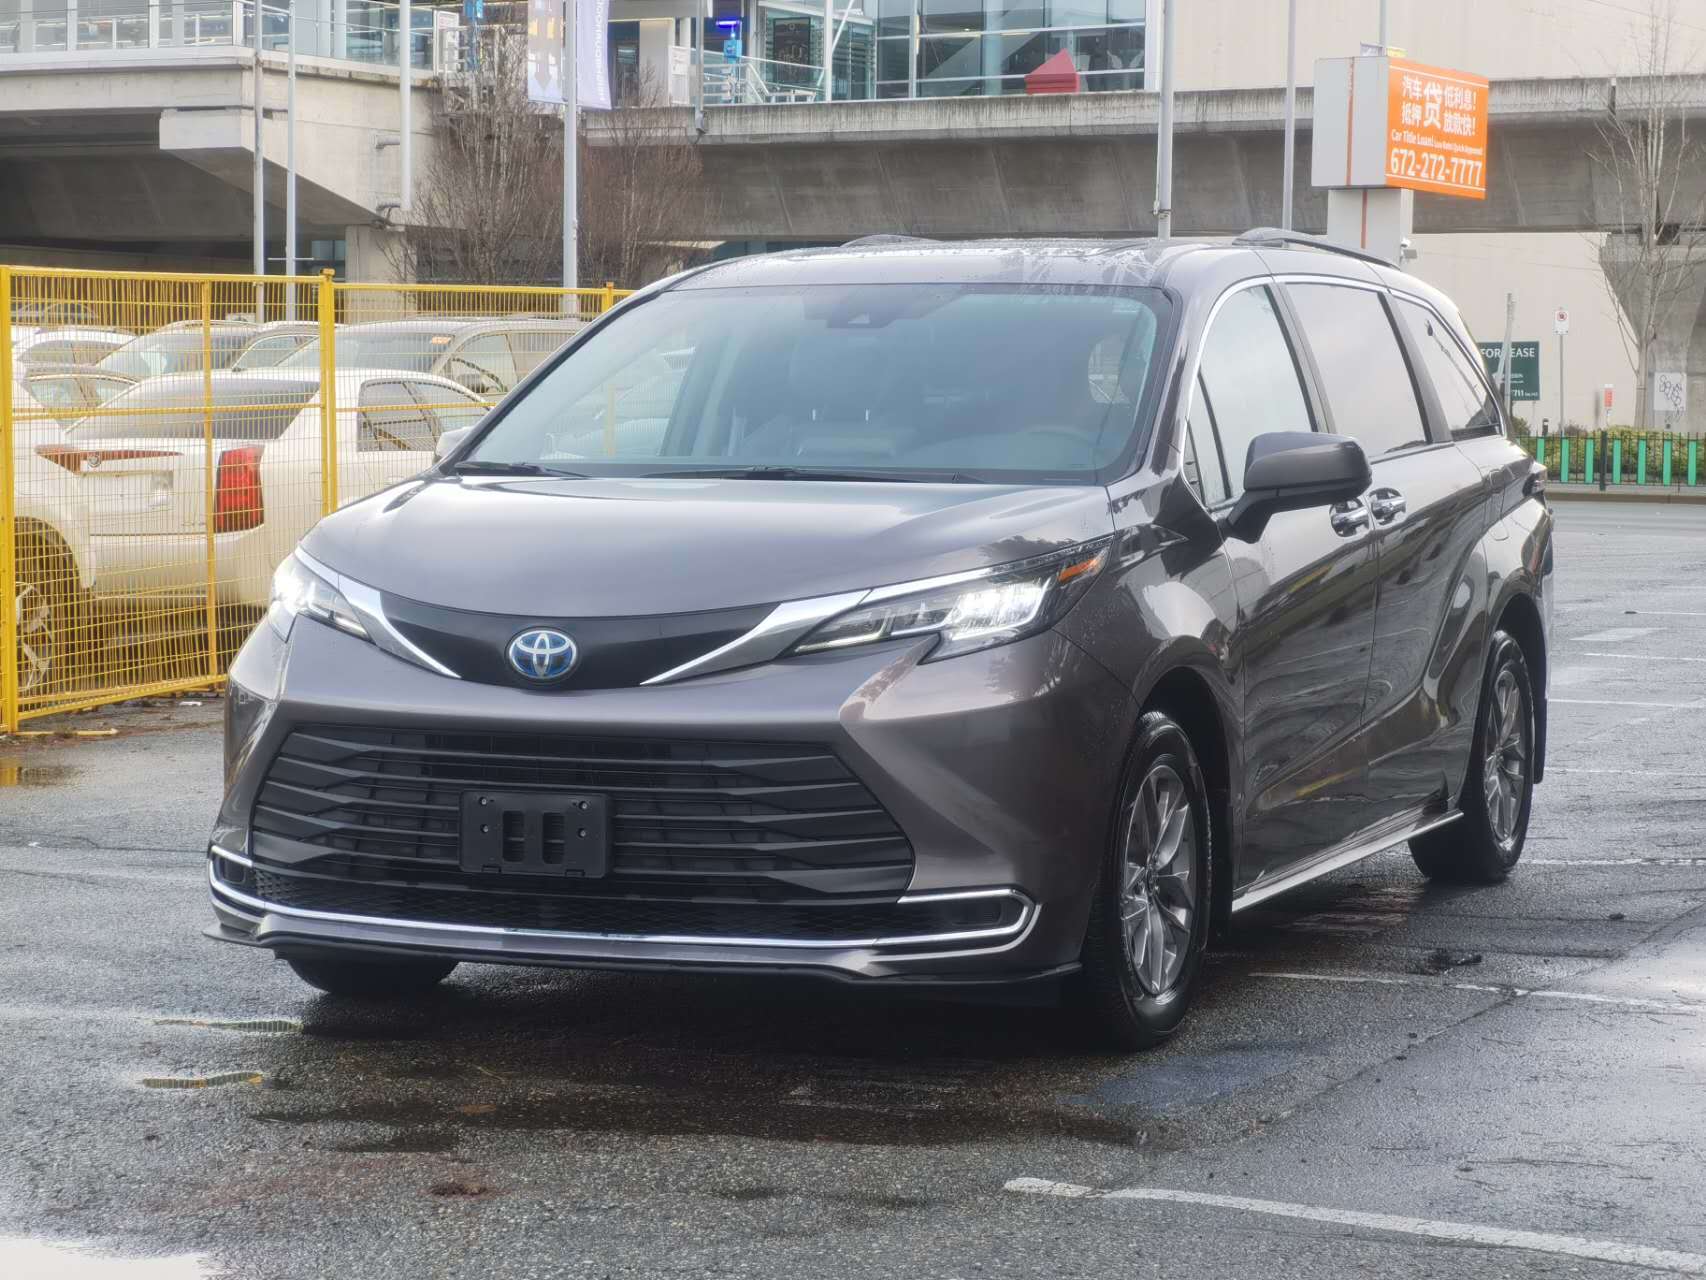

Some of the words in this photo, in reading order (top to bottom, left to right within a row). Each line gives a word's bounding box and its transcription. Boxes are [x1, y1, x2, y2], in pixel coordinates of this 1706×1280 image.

[1391, 128, 1402, 142] Car
[1390, 148, 1483, 187] 672-272-7777
[1509, 347, 1535, 358] EASE
